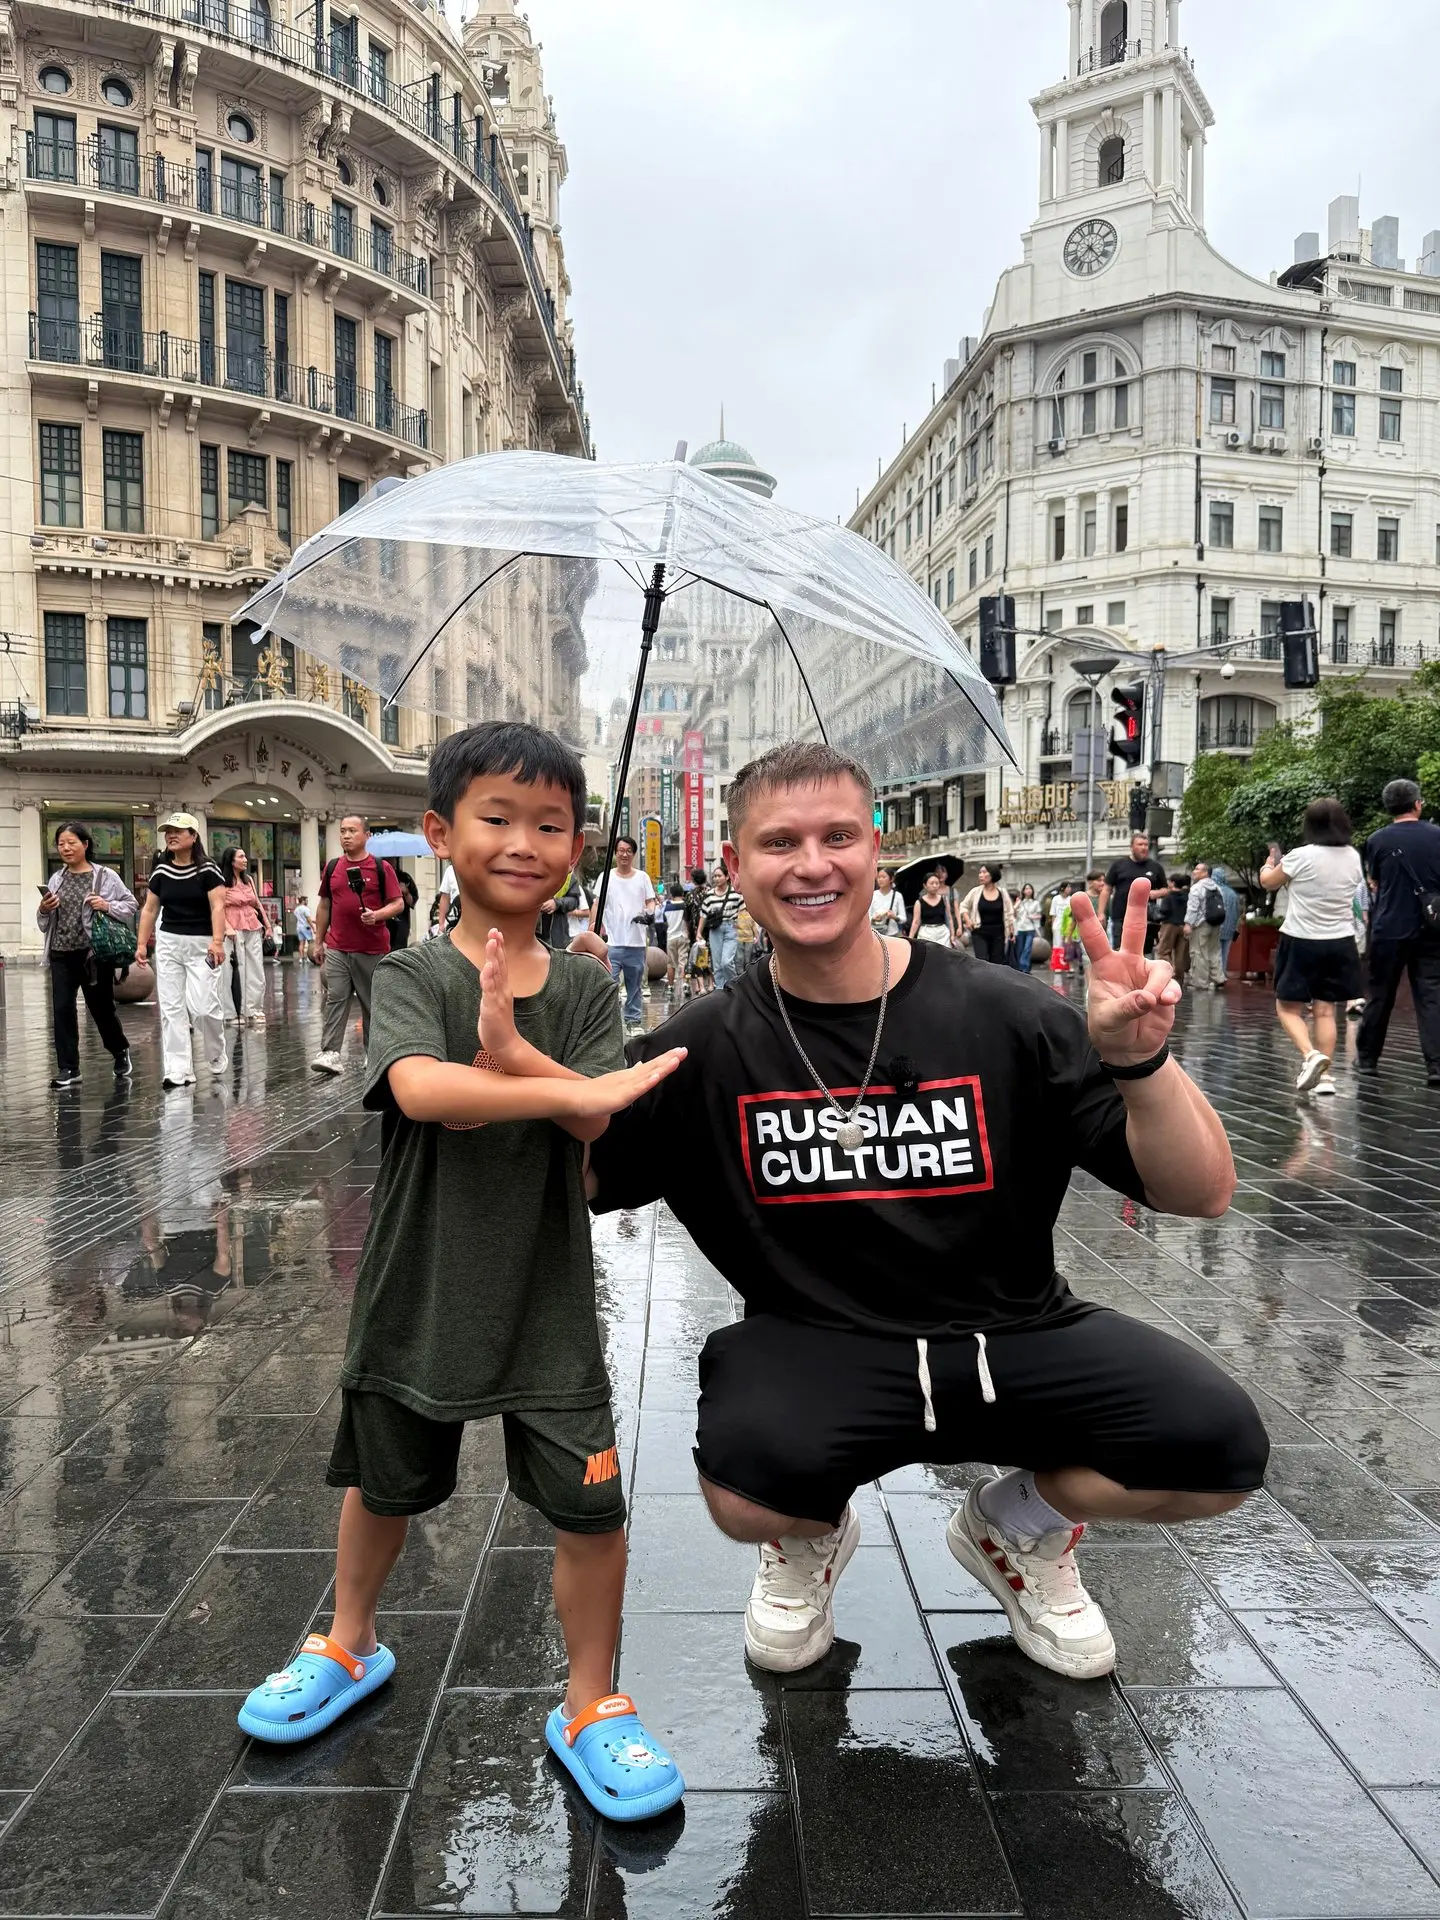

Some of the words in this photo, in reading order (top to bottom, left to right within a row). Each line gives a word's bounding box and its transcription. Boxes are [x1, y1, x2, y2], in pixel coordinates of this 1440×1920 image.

[756, 1097, 969, 1144] RUSSIAN
[761, 1138, 974, 1185] CULTURE
[583, 1445, 619, 1485] NIK
